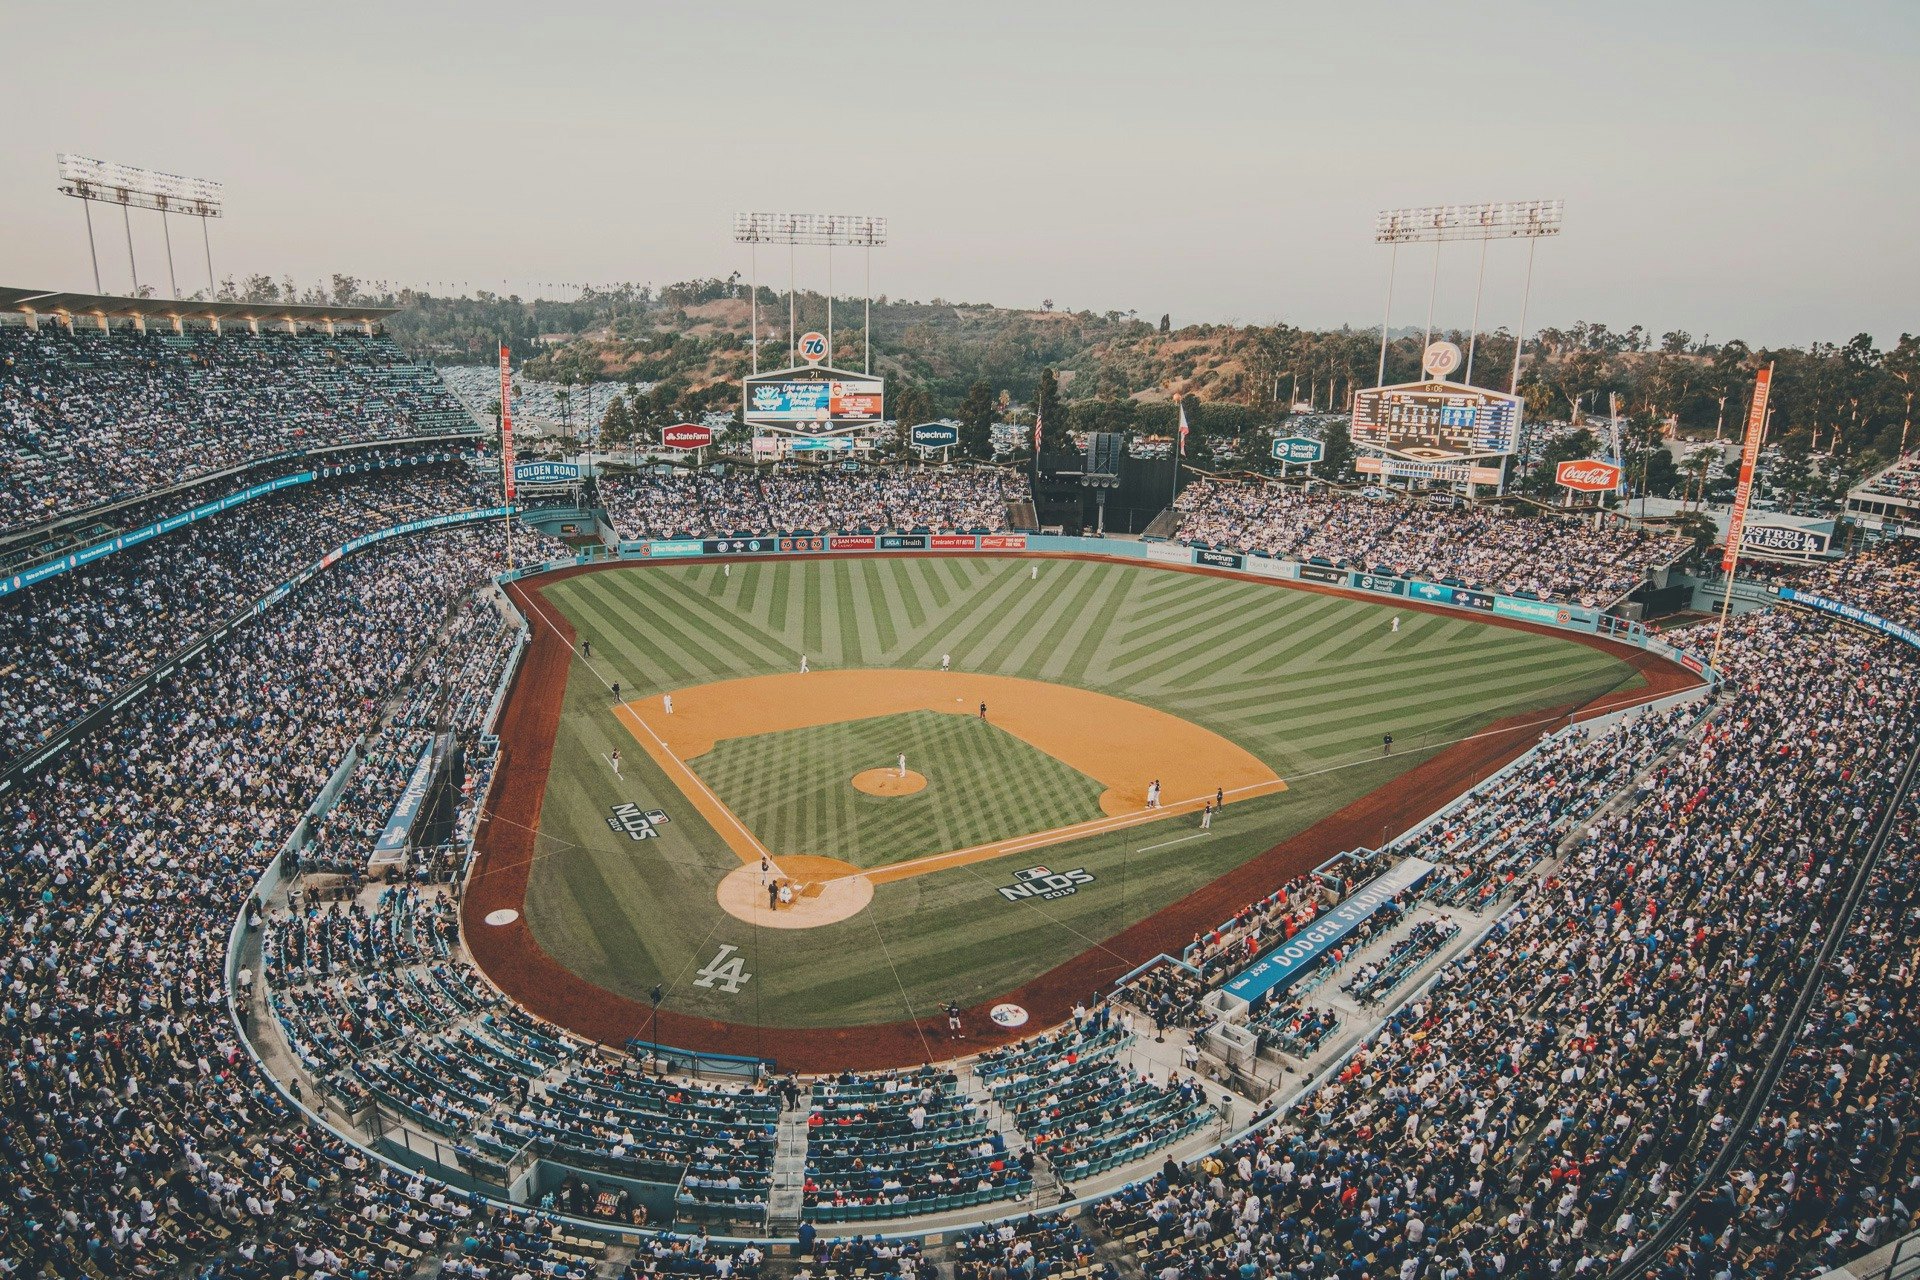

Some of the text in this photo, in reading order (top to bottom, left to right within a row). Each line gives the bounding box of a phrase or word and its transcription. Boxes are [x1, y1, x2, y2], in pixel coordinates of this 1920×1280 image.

[805, 338, 824, 355] 76
[1429, 350, 1452, 367] 76
[915, 431, 952, 440] Spectrum
[1290, 443, 1318, 453] Security
[1742, 422, 1759, 467] Emirates
[1290, 450, 1313, 459] Benefit
[517, 465, 577, 479] GOLDEN ROAD
[397, 524, 414, 533] LISTEN
[422, 516, 448, 527] DODGERS
[448, 514, 466, 523] RADIO
[485, 508, 501, 516] KLAC
[1725, 519, 1741, 563] Emirates
[1203, 552, 1233, 562] Spectrum
[1373, 583, 1393, 592] Benefit
[1374, 577, 1396, 588] Security
[1794, 591, 1819, 605] EVERY
[1819, 598, 1840, 612] PLAY.
[1840, 606, 1863, 620] EVERY
[1883, 620, 1903, 636] LISTEN
[1902, 629, 1910, 639] TO
[607, 817, 623, 832] 2019
[612, 802, 658, 841] NLDS
[998, 868, 1095, 901] NLDS
[1043, 887, 1076, 900] 2019
[1272, 878, 1401, 967] DODGER STADIUM
[692, 943, 753, 994] LA
